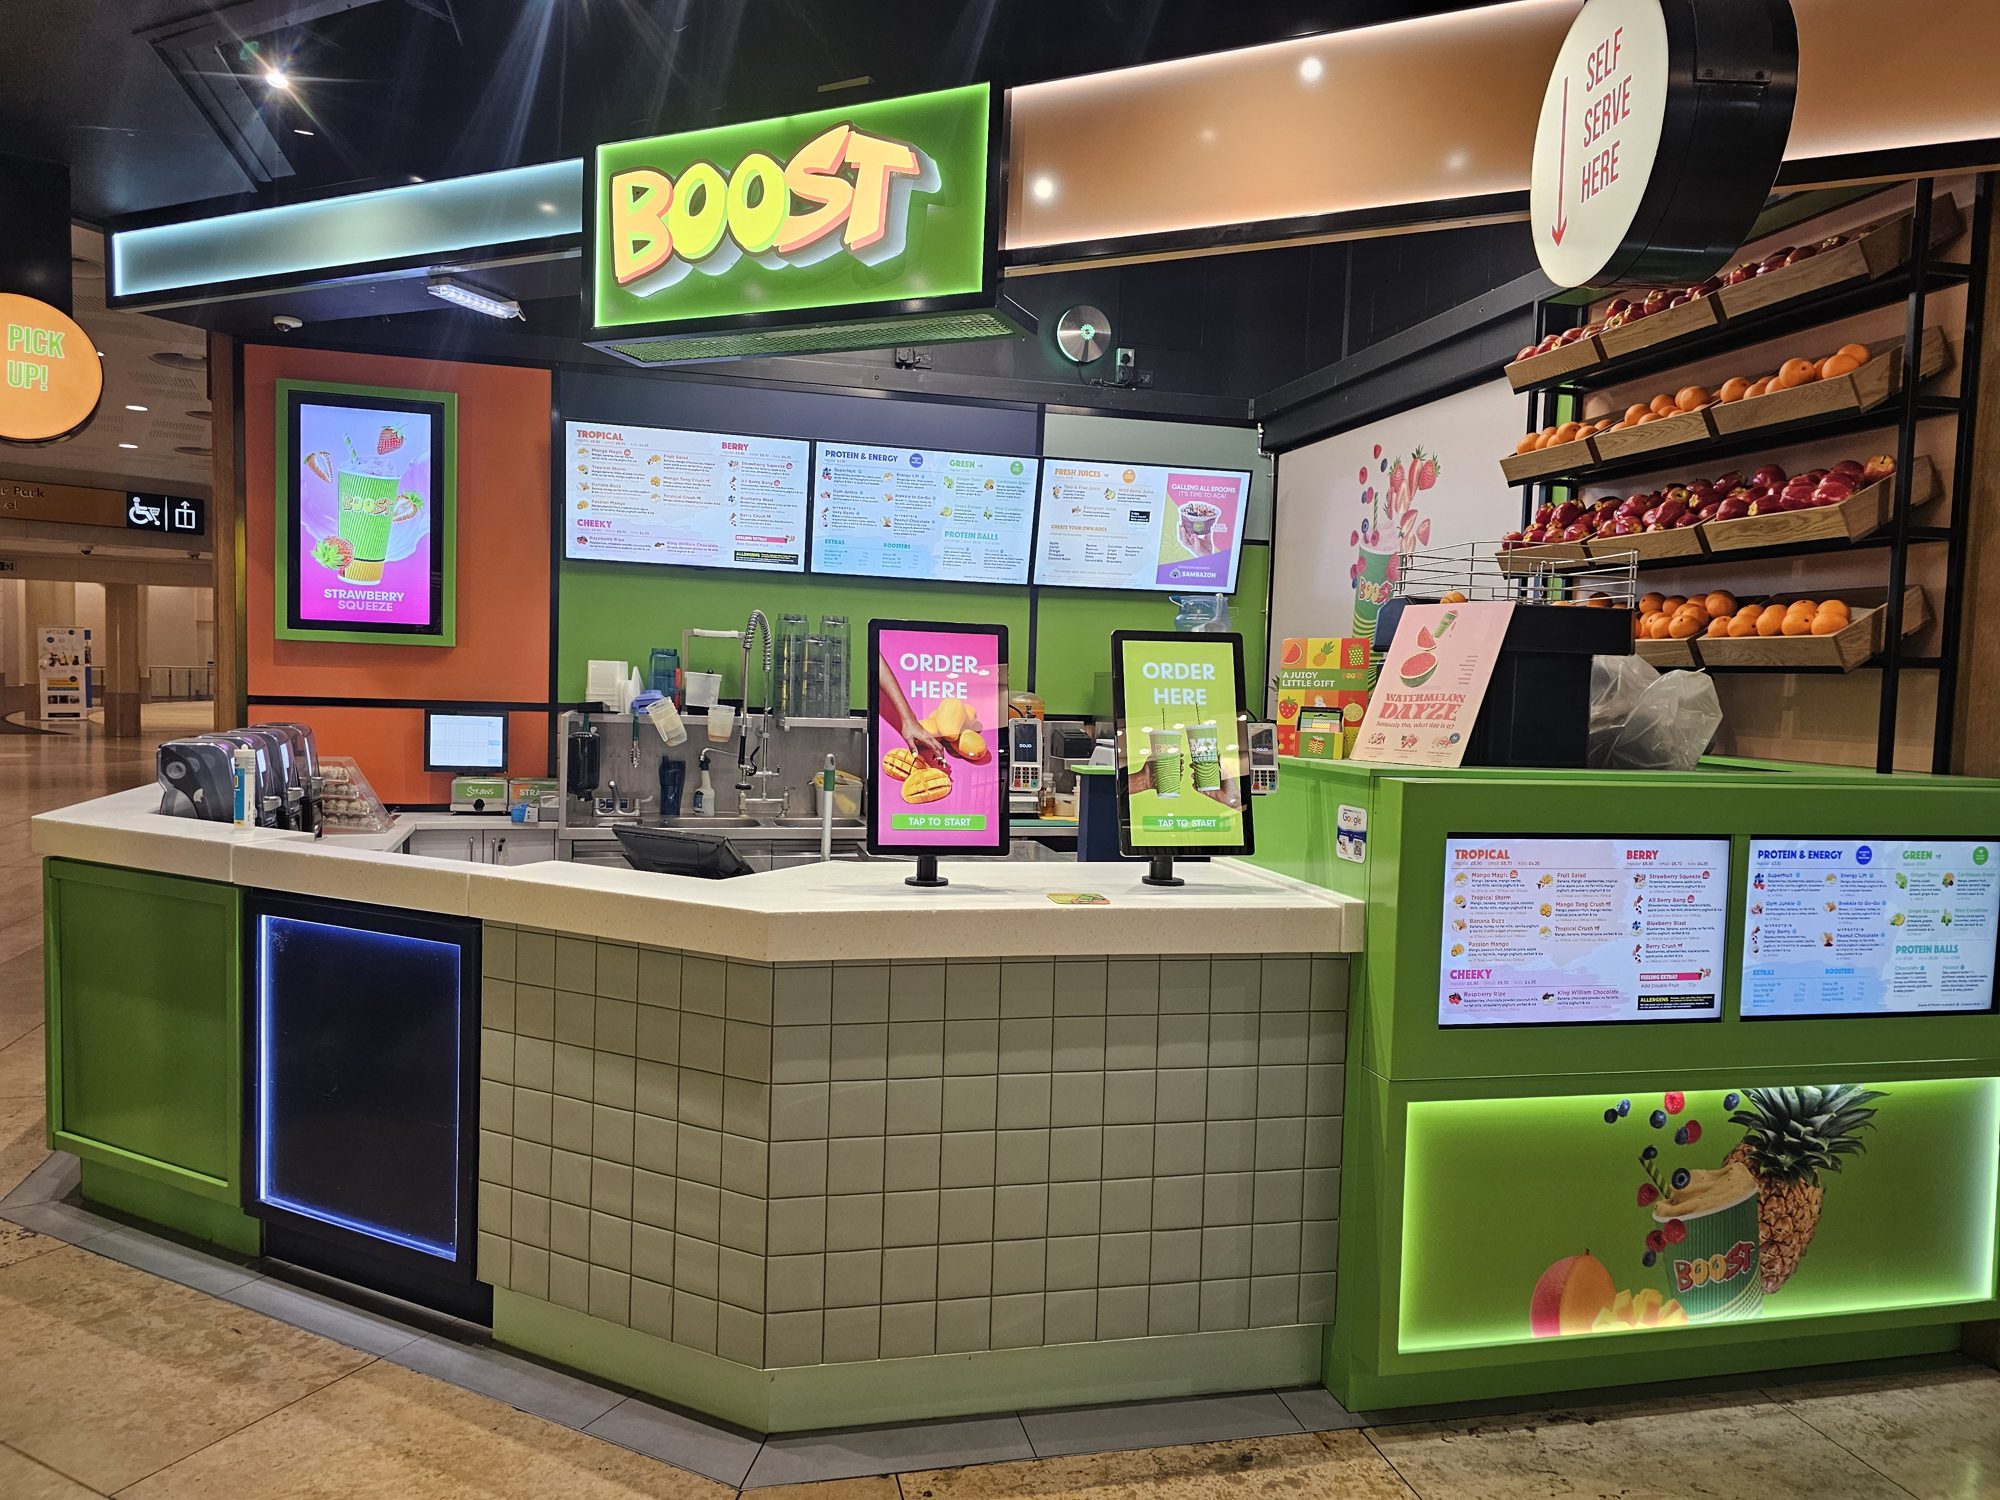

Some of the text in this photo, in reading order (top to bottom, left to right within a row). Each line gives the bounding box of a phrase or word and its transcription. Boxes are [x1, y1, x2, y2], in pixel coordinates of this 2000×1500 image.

[1586, 26, 1623, 92] SELF
[1584, 74, 1632, 148] SERVE
[1581, 140, 1620, 203] HERE
[611, 120, 924, 290] BOOST
[8, 324, 65, 358] PICK
[8, 360, 48, 391] UP!
[577, 430, 623, 440] TROPICAL
[722, 442, 748, 451] BERRY
[826, 450, 858, 459] PROTEIN
[14, 486, 45, 497] Park
[342, 492, 394, 515] BOOST
[577, 519, 612, 528] CHEEKY
[324, 588, 404, 601] STRAWBERRY
[338, 600, 393, 611] SQUEEZE
[900, 653, 978, 674] ORDER
[1143, 662, 1215, 680] ORDER
[911, 680, 968, 699] HERE
[1154, 688, 1206, 705] HERE
[1386, 693, 1466, 703] WATERMELON
[1379, 703, 1461, 721] DAYZE
[909, 817, 971, 826] TAP TO START
[1158, 819, 1216, 827] TAP TO START
[1455, 850, 1510, 859] TROPICAL
[1627, 850, 1658, 859] BERRY
[1758, 850, 1843, 859] PROTEIN & ENERGY
[1903, 851, 1932, 860] GREEN
[1896, 945, 1958, 954] PROTEIN BALLS
[1450, 969, 1492, 980] CHEEKY
[1673, 1241, 1755, 1293] BOOST
